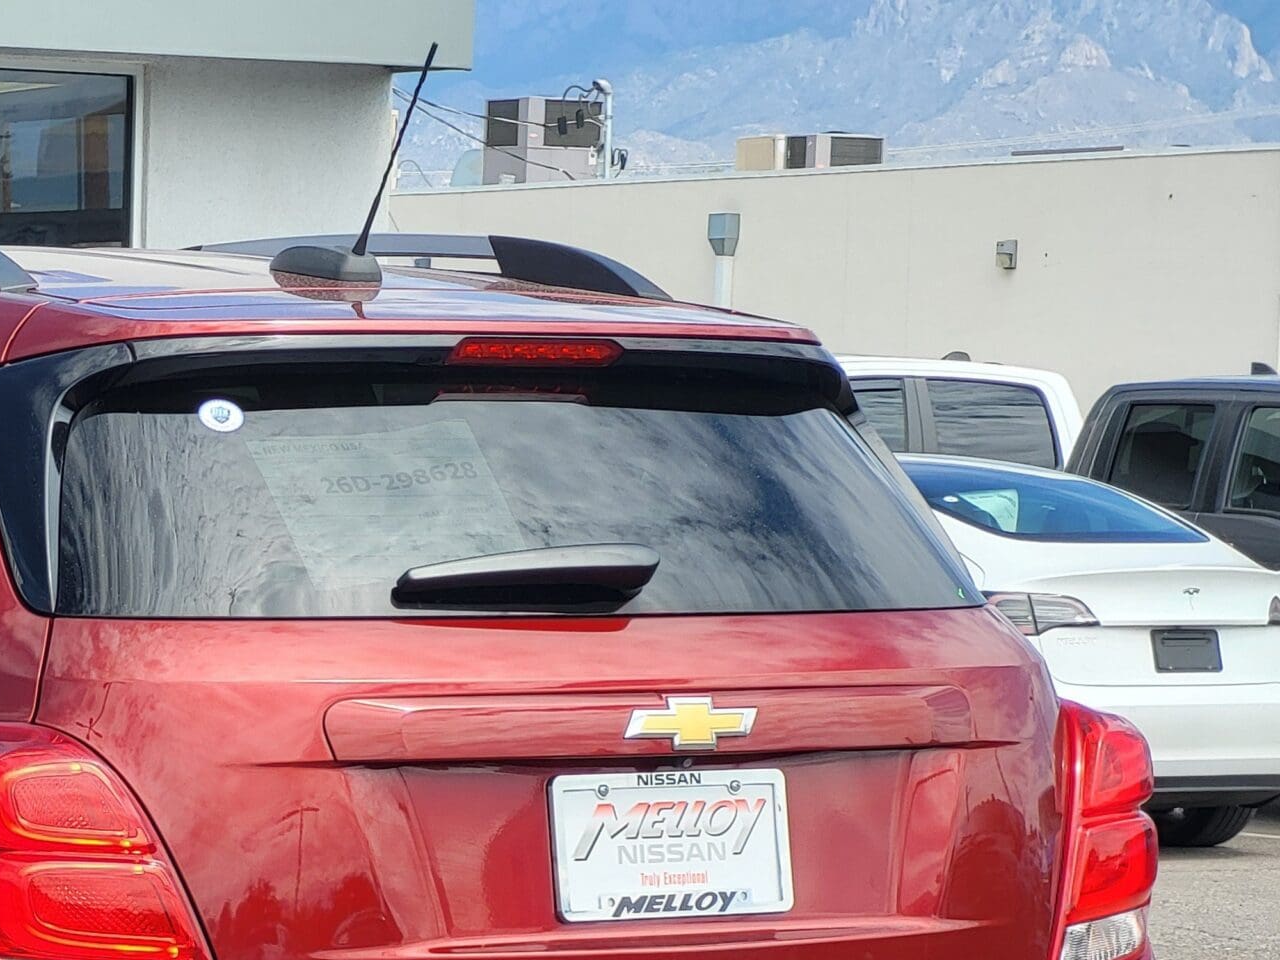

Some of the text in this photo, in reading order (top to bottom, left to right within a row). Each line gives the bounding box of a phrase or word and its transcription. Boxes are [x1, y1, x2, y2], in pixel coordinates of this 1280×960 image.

[321, 461, 479, 495] 26D-298628
[637, 772, 702, 787] NISSAN
[573, 798, 767, 862] MELLOY
[617, 842, 727, 865] NISSAN
[641, 870, 709, 888] Truly Exceptional
[612, 891, 738, 918] MELLOY
